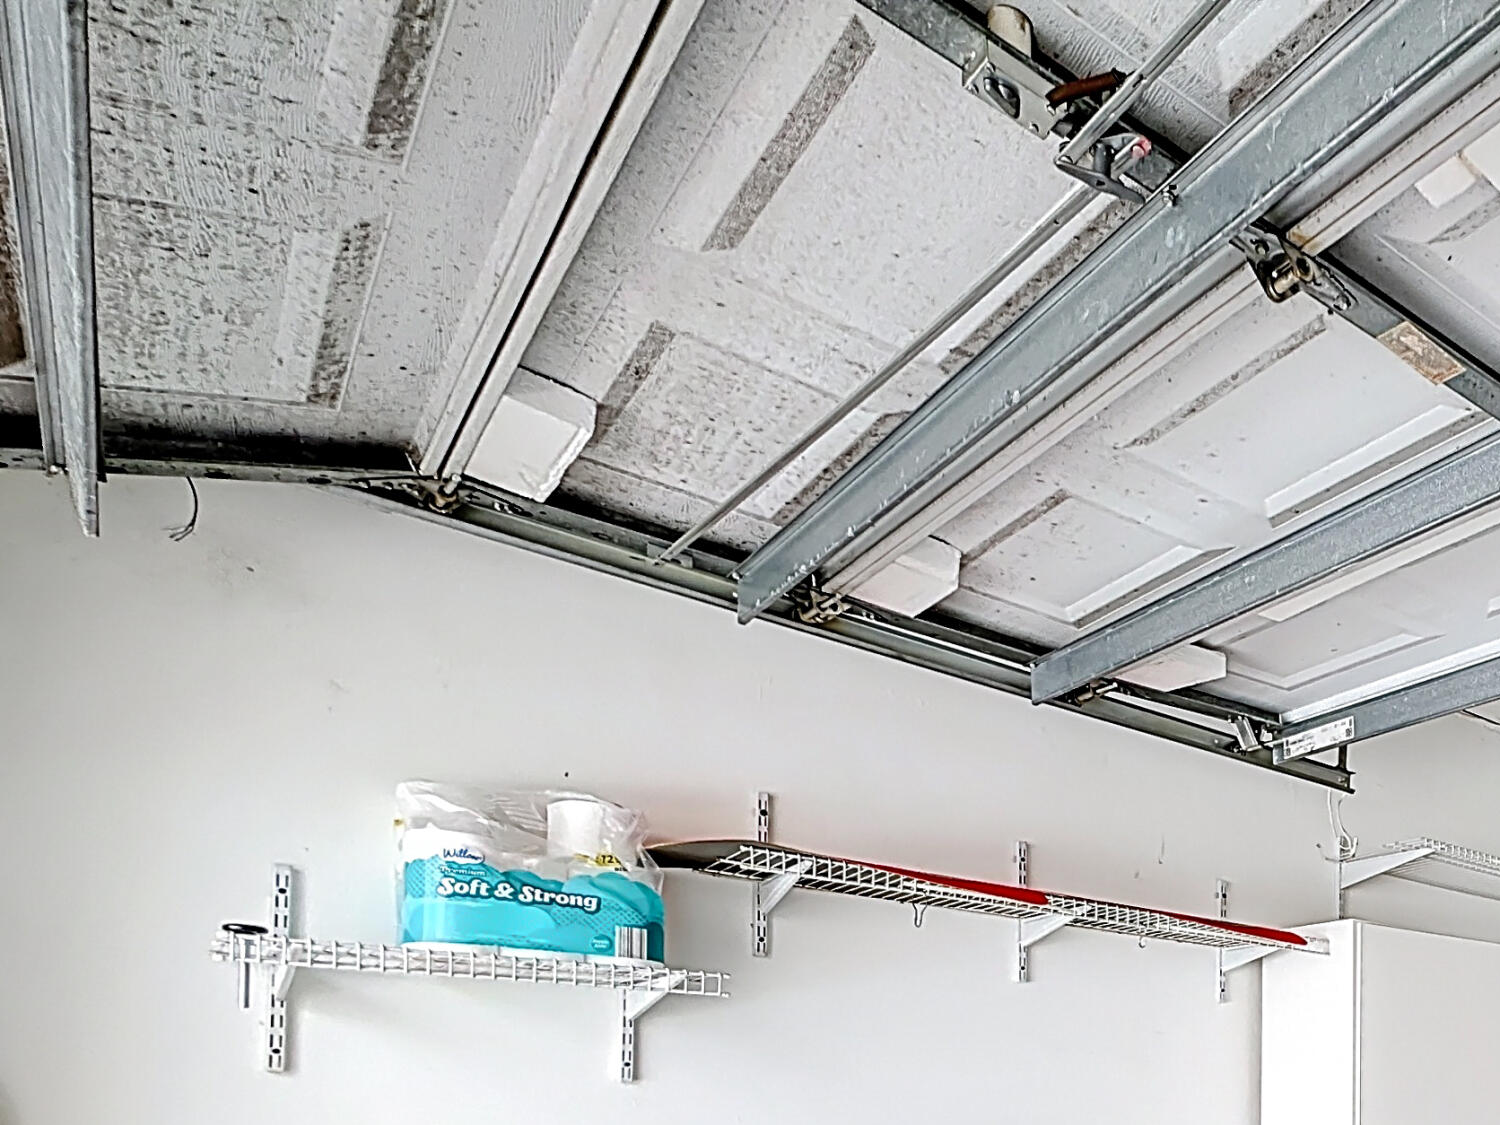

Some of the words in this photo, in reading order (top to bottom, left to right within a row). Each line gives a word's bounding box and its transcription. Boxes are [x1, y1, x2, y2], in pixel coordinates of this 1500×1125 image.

[437, 877, 490, 897] Soft
[494, 883, 513, 899] &
[517, 886, 598, 912] Strong
